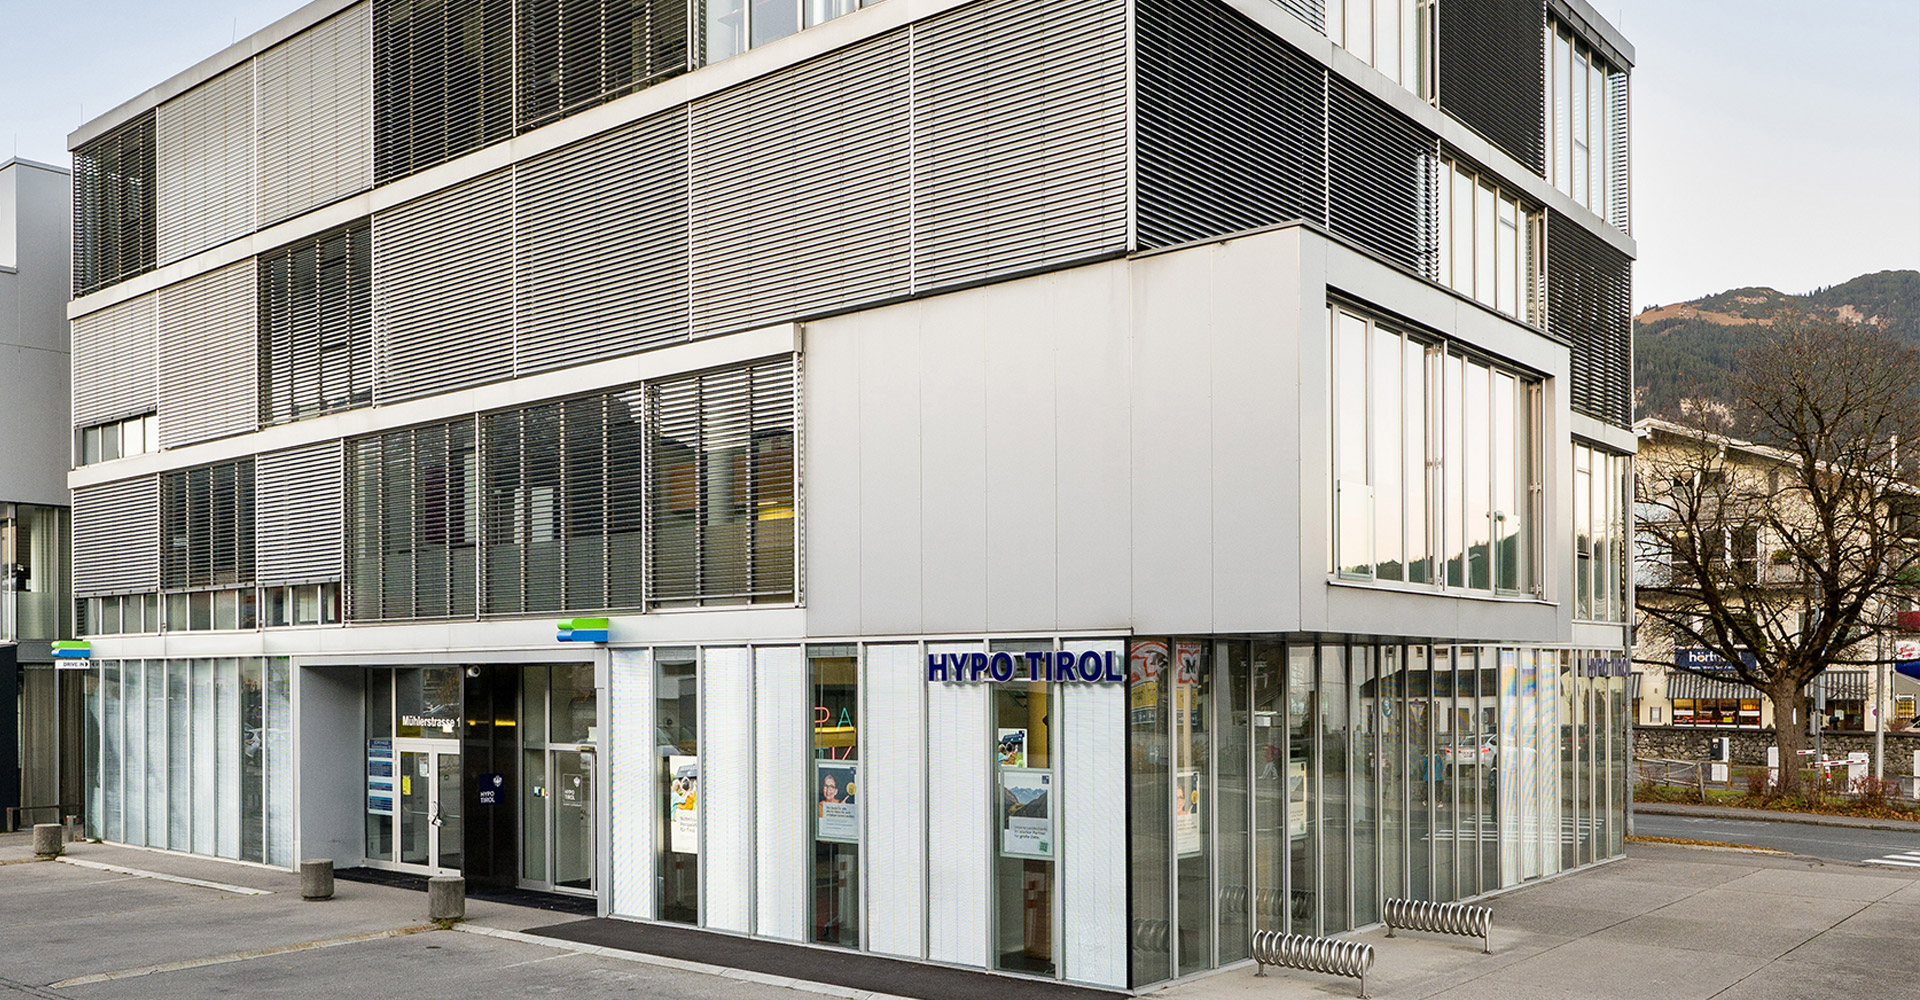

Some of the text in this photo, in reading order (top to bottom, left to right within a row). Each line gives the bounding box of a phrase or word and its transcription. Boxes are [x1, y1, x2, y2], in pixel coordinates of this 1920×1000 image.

[928, 650, 1123, 682] HYPO TIROL
[402, 715, 455, 727] Mühlerstrasse
